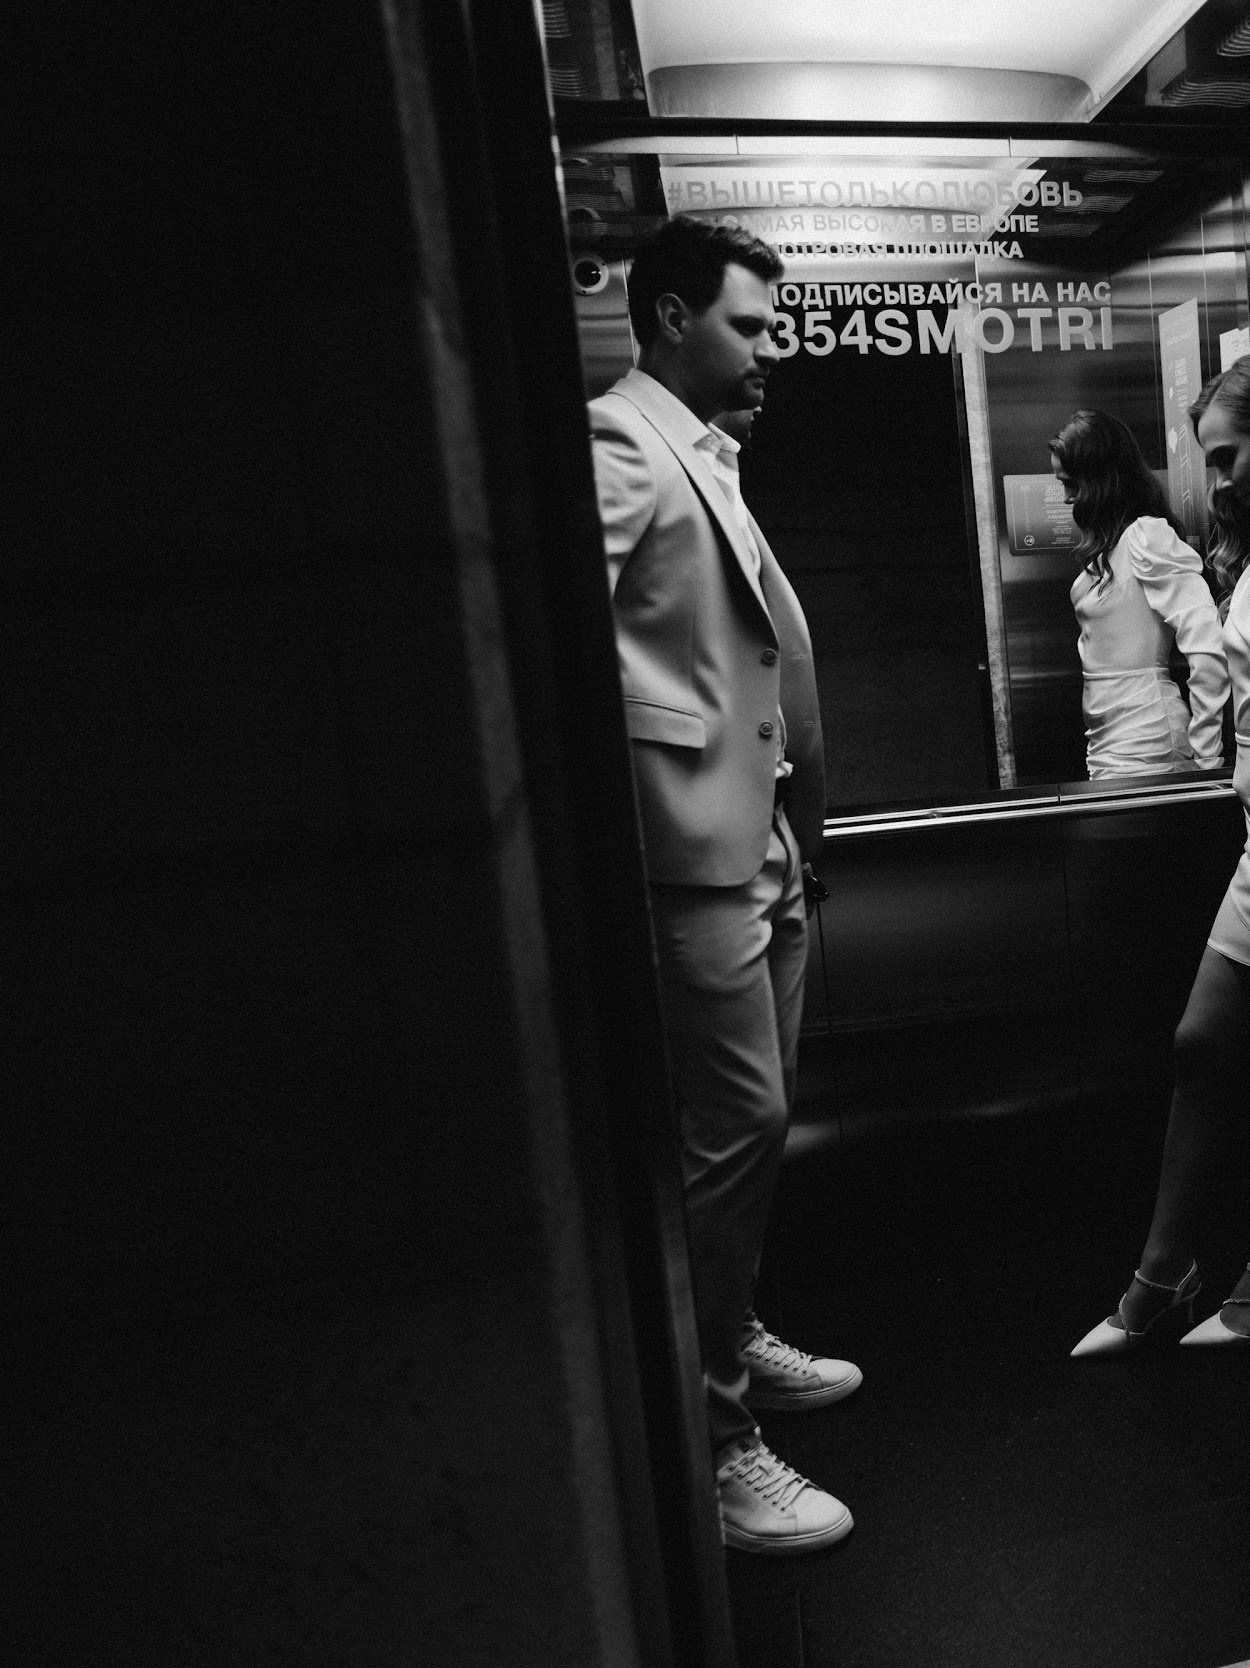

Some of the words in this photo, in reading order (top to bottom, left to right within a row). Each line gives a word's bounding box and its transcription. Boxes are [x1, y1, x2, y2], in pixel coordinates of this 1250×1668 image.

[813, 214, 926, 234] ВЫСОКАЯ
[931, 214, 947, 233] В
[952, 214, 1039, 233] ЕВРОПЕ
[774, 241, 888, 259] ОТРОВАЯ
[769, 278, 1002, 310] ПОДПИСЫВАЙСЯ
[1012, 282, 1050, 303] НА
[1057, 281, 1112, 303] НАС
[773, 307, 1113, 358] 354SMOTRI
